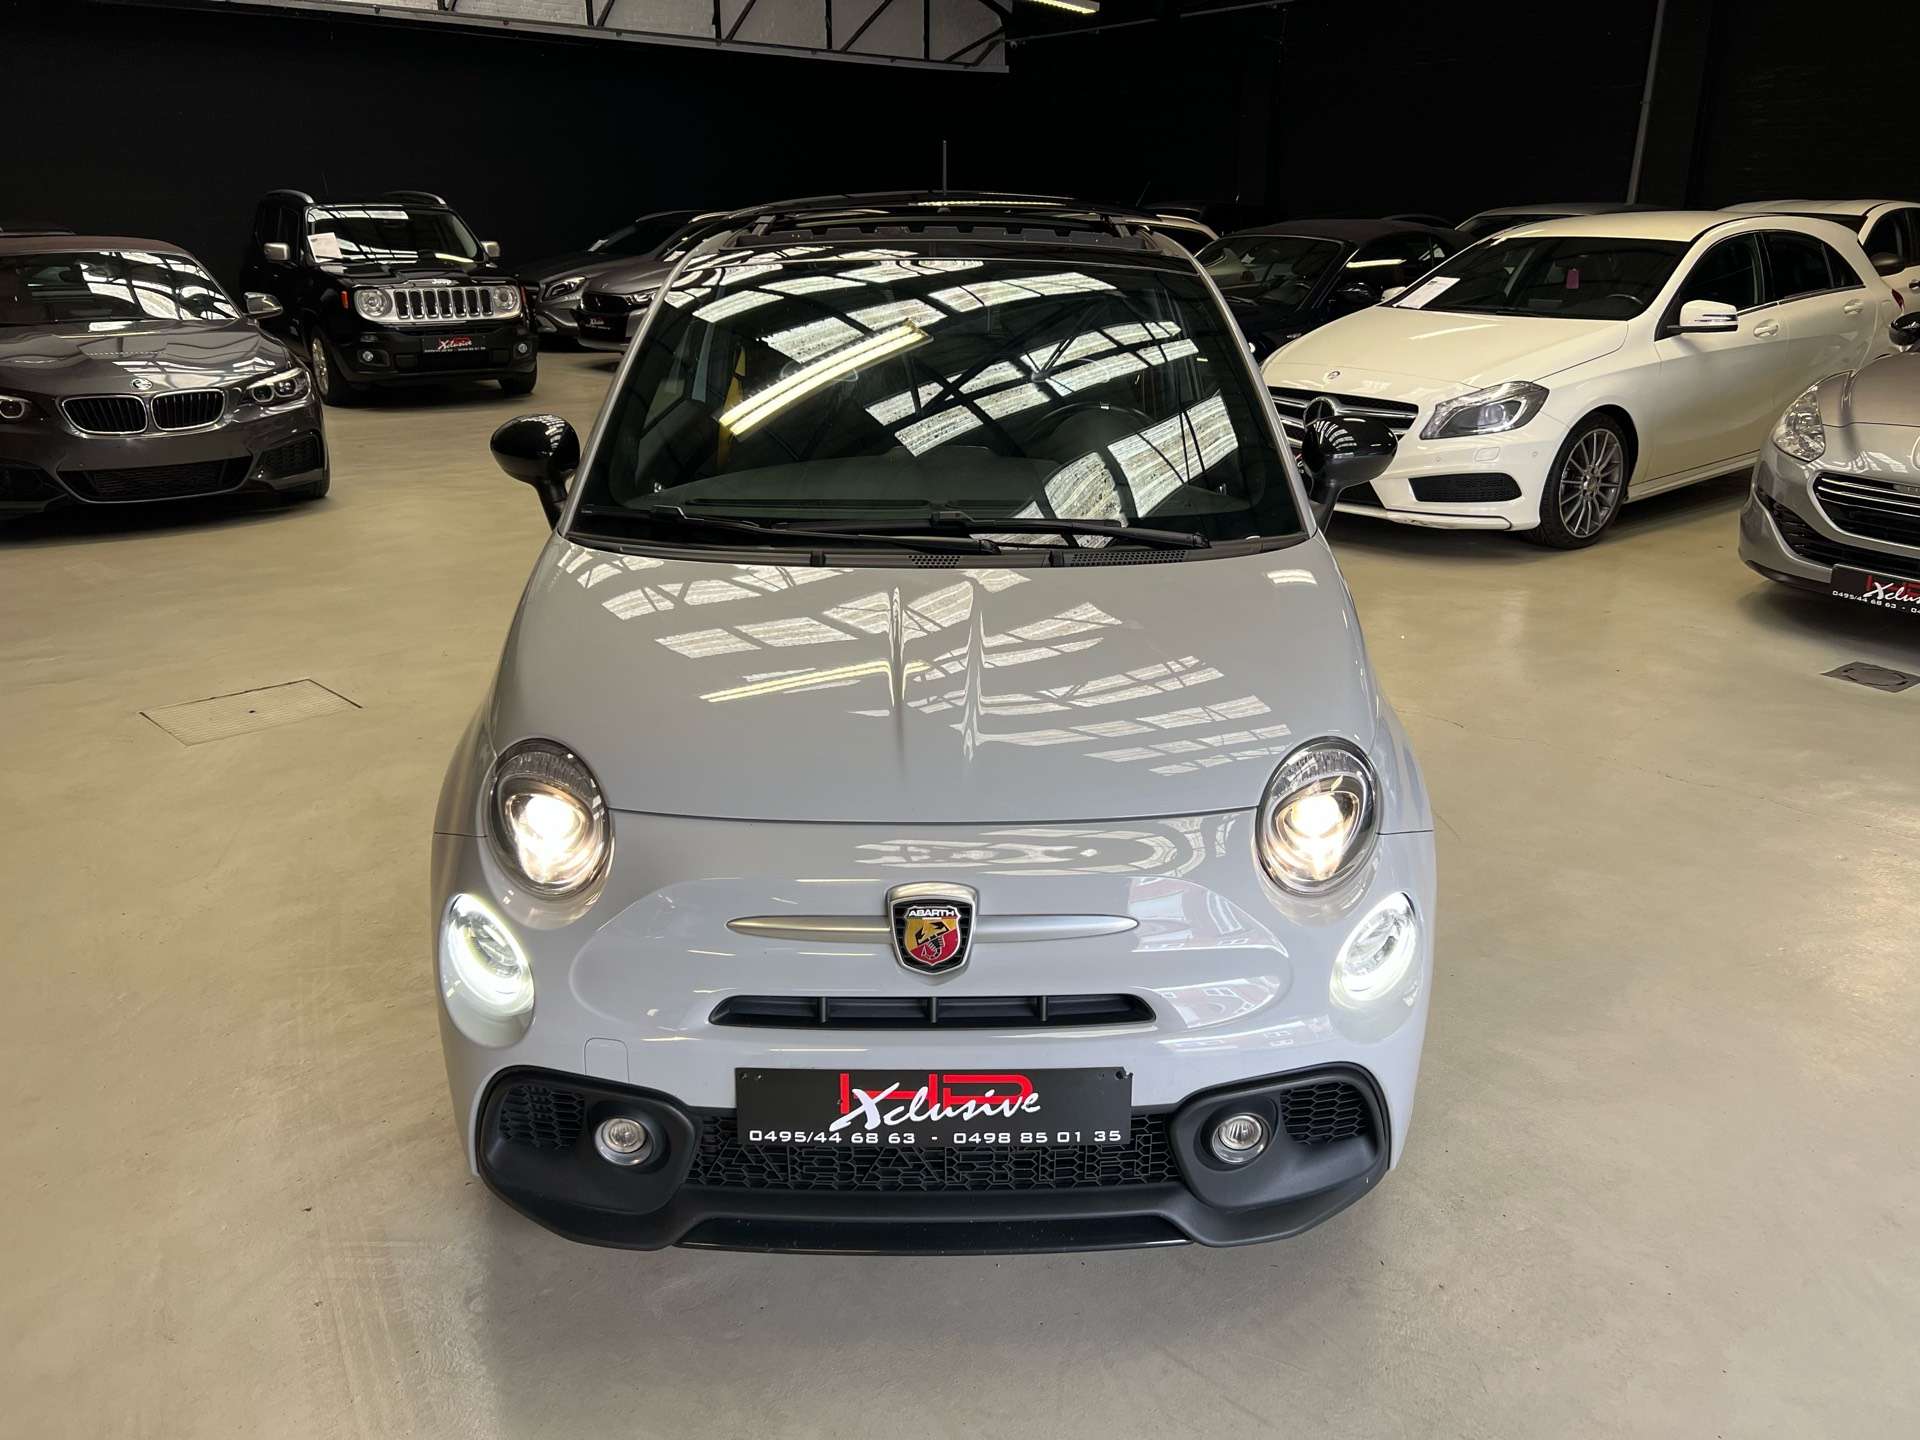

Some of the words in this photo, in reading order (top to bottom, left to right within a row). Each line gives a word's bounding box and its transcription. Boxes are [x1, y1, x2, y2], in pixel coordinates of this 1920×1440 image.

[1832, 590, 1868, 603] 0495/44
[908, 909, 956, 917] ABARTH
[829, 1082, 1041, 1132] Xclusive
[749, 1130, 842, 1144] 0495/44
[851, 1132, 879, 1144] 68
[888, 1132, 916, 1144] 63
[953, 1132, 1011, 1144] 0498
[1020, 1132, 1048, 1144] 85
[1057, 1131, 1081, 1143] 01
[1094, 1130, 1122, 1143] 35
